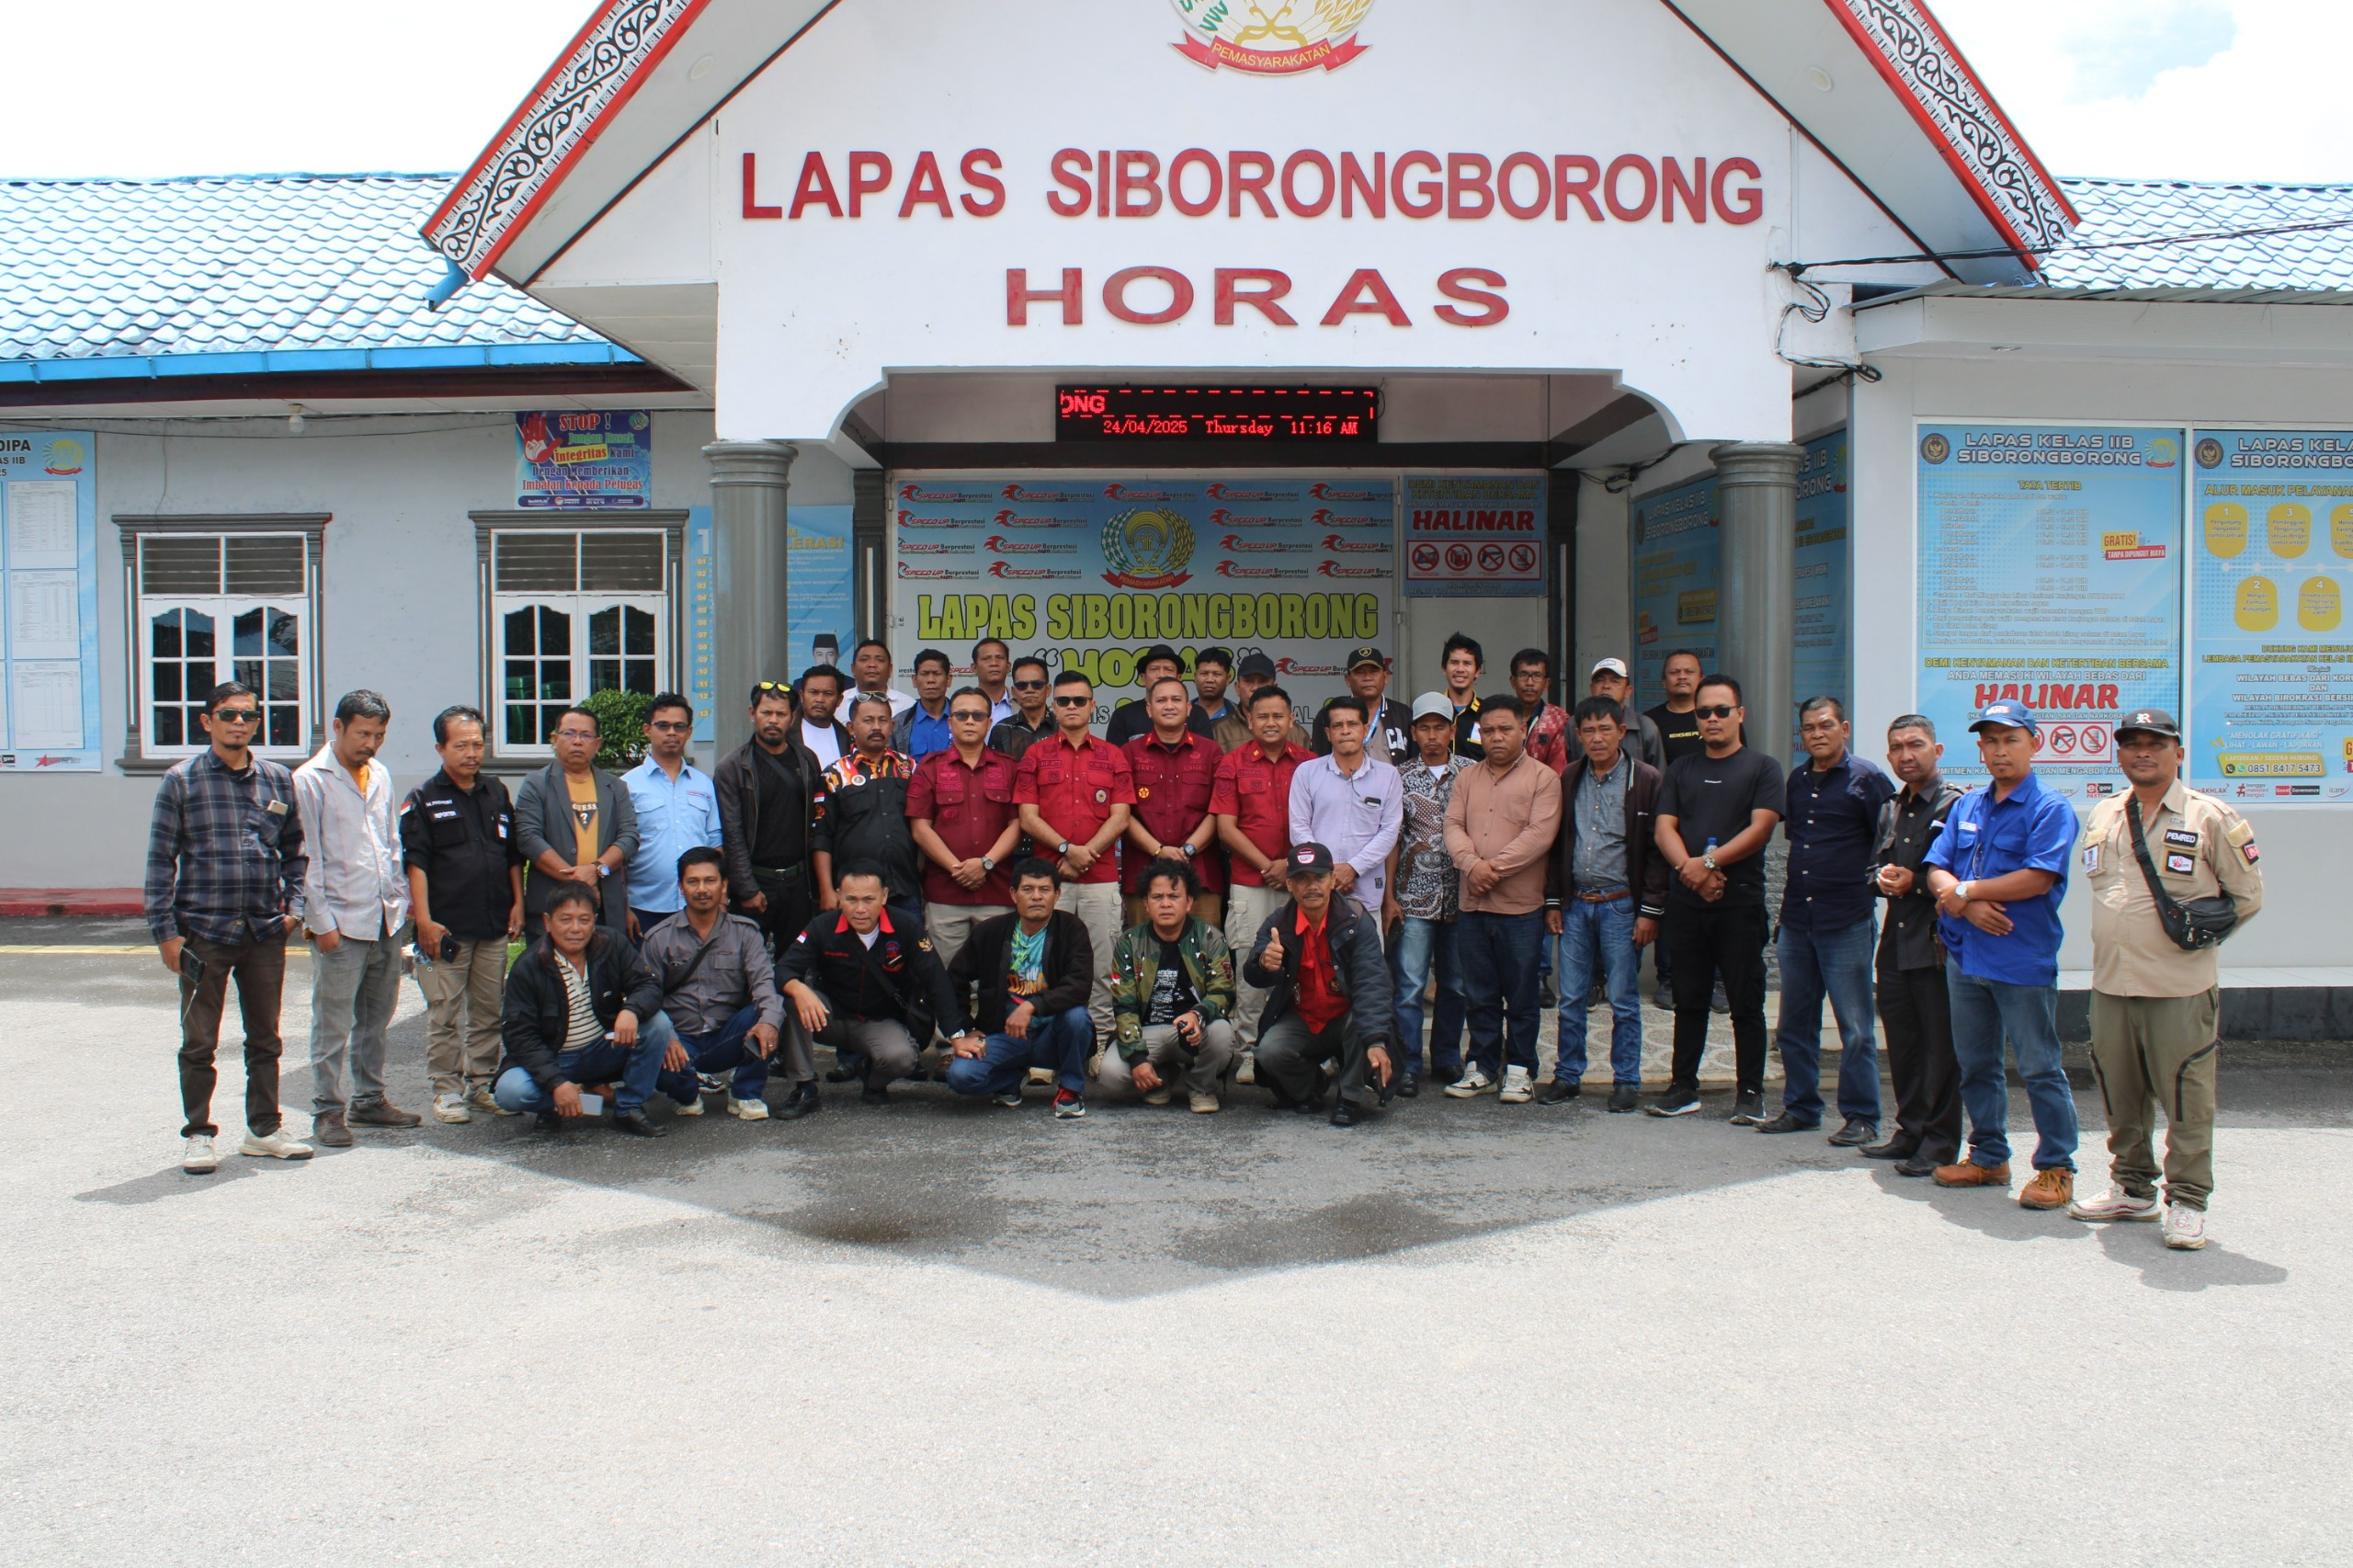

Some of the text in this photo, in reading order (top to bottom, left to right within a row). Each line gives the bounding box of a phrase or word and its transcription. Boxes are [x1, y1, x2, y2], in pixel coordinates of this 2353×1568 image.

[1211, 42, 1331, 68] PEMASYARAKATAN
[742, 148, 1763, 225] LAPAS SIBORONGBORONG
[1006, 266, 1509, 327] HORAS
[559, 414, 600, 431] STOP
[1103, 419, 1358, 437] 24/04/2025 Thursday 11:16 AM
[568, 432, 635, 445] Jangan Rusak
[1965, 433, 2134, 449] LAPAS KELAS IIB
[2238, 437, 2303, 451] LAPAS
[609, 448, 634, 458] Kami
[1957, 449, 2142, 466] SIBORONGBORONG
[12, 456, 26, 464] IIB
[1813, 449, 1827, 471] IIB
[532, 466, 629, 477] Dengan Memberikan
[522, 479, 642, 492] Imbalan Kepada Petugas
[1408, 479, 1434, 489] DEMI
[1438, 480, 1514, 489] KENYAMANAN
[2018, 481, 2082, 490] TATA TERTIB
[2204, 484, 2238, 495] ALUR
[2241, 484, 2285, 495] MASUK
[1411, 490, 1537, 499] KETERTIBAN BERSAMA
[2287, 507, 2293, 516] 3
[1412, 509, 1535, 531] HALINAR
[788, 537, 844, 549] ERASI
[2104, 534, 2136, 547] GRATIS!
[1119, 574, 1176, 587] PEMASYARAKATAN
[2254, 581, 2261, 589] 2
[918, 593, 1379, 640] LAPAS SIBORONGBORONG
[1925, 658, 2168, 668] DEMI KENYAMANAN DAN KETERTIBAN BERSAMA
[2202, 654, 2242, 663] LEMBAGA
[2243, 654, 2317, 663] PEMASYARAKATAN
[1948, 671, 2145, 680] ANDA MEMASUKI WILAYAH BEBAS DARI
[1974, 683, 2120, 710] HALINAR
[1669, 731, 1699, 739] EIGER
[2284, 741, 2324, 749] LAPORKAN
[2040, 767, 2104, 776] DAN MENGABDI
[2247, 765, 2321, 773] 0851 8417 5473
[2098, 785, 2112, 793] gov
[573, 802, 597, 811] GUESS
[2165, 831, 2196, 844] PEMRED
